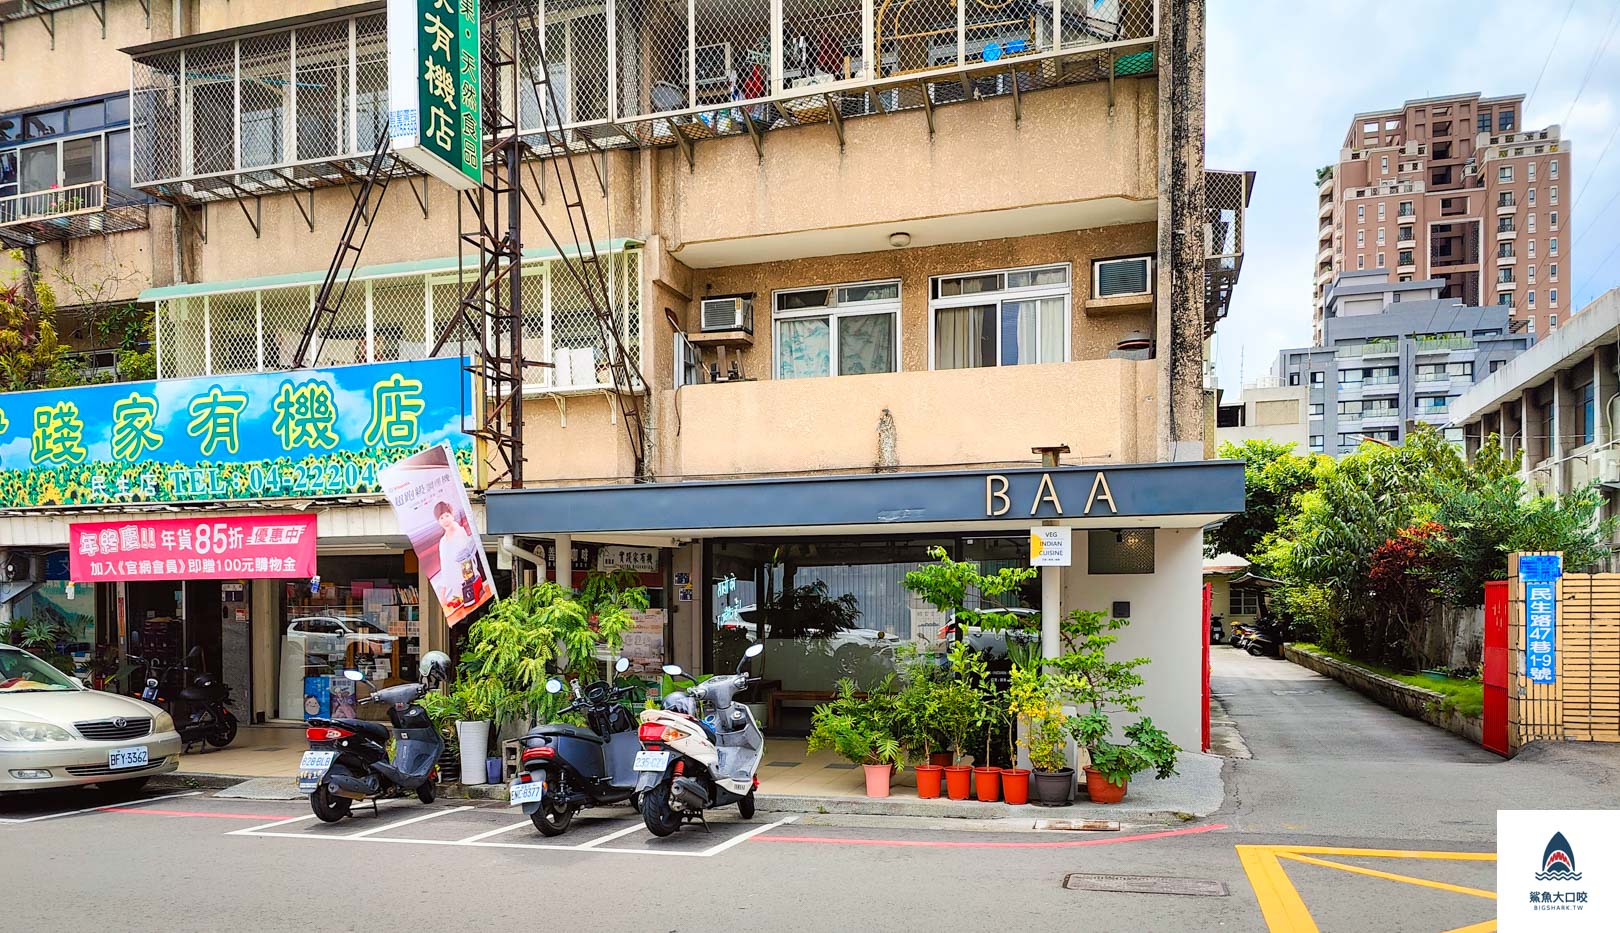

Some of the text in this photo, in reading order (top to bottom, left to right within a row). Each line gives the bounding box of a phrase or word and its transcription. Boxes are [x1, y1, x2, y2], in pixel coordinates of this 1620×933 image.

[0, 373, 426, 466] 踐家有機店
[91, 474, 157, 497] 民生店
[249, 461, 389, 492] 04-22204
[986, 472, 1117, 516] BAA
[254, 526, 299, 544] 優惠中
[90, 556, 296, 576] 加入《官網會員》即贈100元購物金
[1529, 587, 1553, 680] 民生路47巷1-9號
